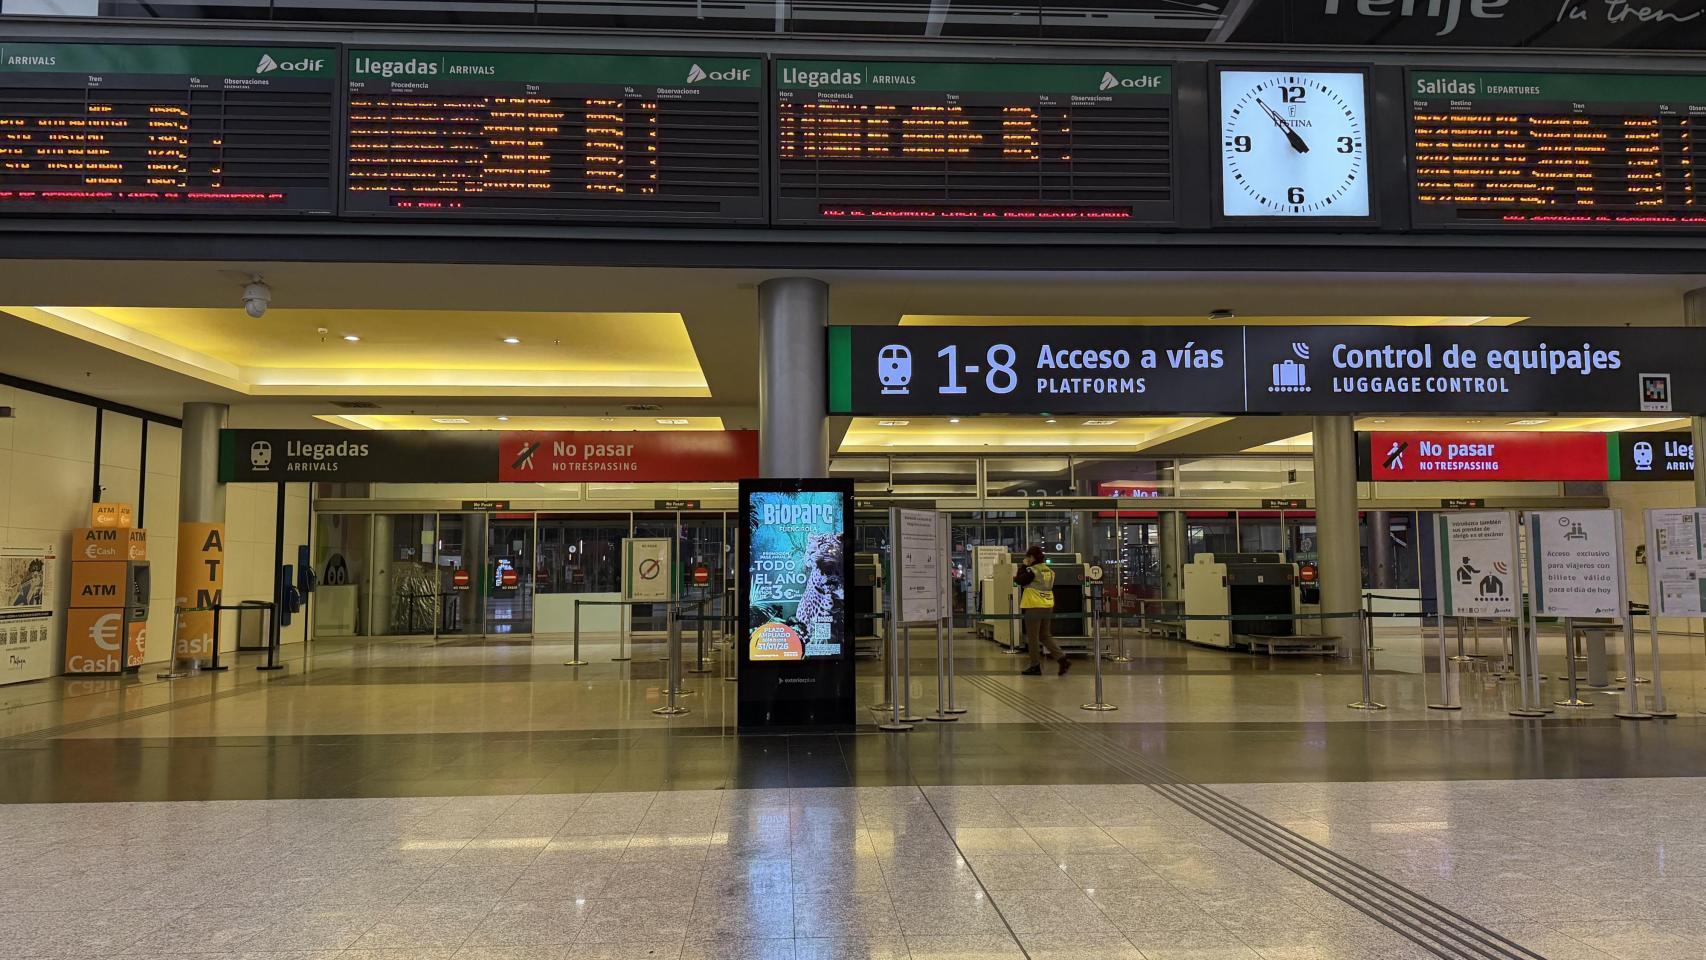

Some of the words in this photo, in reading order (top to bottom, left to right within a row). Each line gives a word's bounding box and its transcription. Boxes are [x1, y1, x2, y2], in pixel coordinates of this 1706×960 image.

[8, 56, 56, 65] ARRIVALS
[280, 58, 325, 72] adif
[355, 57, 438, 78] Llegadas
[449, 65, 495, 75] ARRIVALS
[709, 67, 751, 81] adif
[783, 67, 861, 87] Llegadas
[224, 78, 269, 86] Observaciones
[872, 75, 916, 85] ARRIVALS
[1120, 75, 1162, 88] adif
[1417, 78, 1476, 94] Salidas
[1278, 86, 1306, 103] 12
[1487, 85, 1540, 95] DEPARTURES
[1450, 99, 1472, 107] Destino
[1234, 135, 1251, 153] 9
[1337, 136, 1354, 154] 3
[1288, 187, 1305, 204] 6
[1037, 344, 1130, 369] Acceso
[1141, 350, 1157, 369] a
[1166, 341, 1224, 369] vías
[1332, 343, 1432, 370] Control
[1442, 343, 1477, 369] de
[1487, 342, 1621, 375] equipajes
[937, 343, 1018, 394] 1-8
[1037, 377, 1147, 394] PLATFORMS
[1333, 377, 1421, 393] LUGGAGE
[1426, 377, 1509, 393] CONTROL
[287, 440, 369, 460] Llegadas
[553, 441, 577, 457] No
[584, 444, 634, 460] pasar
[1420, 440, 1442, 457] No
[1448, 444, 1495, 460] pasar
[287, 462, 338, 471] ARRIVALS
[552, 462, 566, 471] NO
[568, 462, 637, 471] TRESPASSING
[1420, 461, 1433, 470] NO
[1435, 461, 1499, 470] TRESPASSING
[86, 530, 117, 540] ATM
[129, 531, 146, 541] ATM
[754, 560, 795, 571] TODO
[1566, 562, 1595, 570] viajeros
[755, 573, 772, 584] EL
[775, 571, 807, 584] AÑO
[81, 584, 116, 596] ATM
[1598, 587, 1611, 595] hoy
[68, 654, 119, 673] Cash
